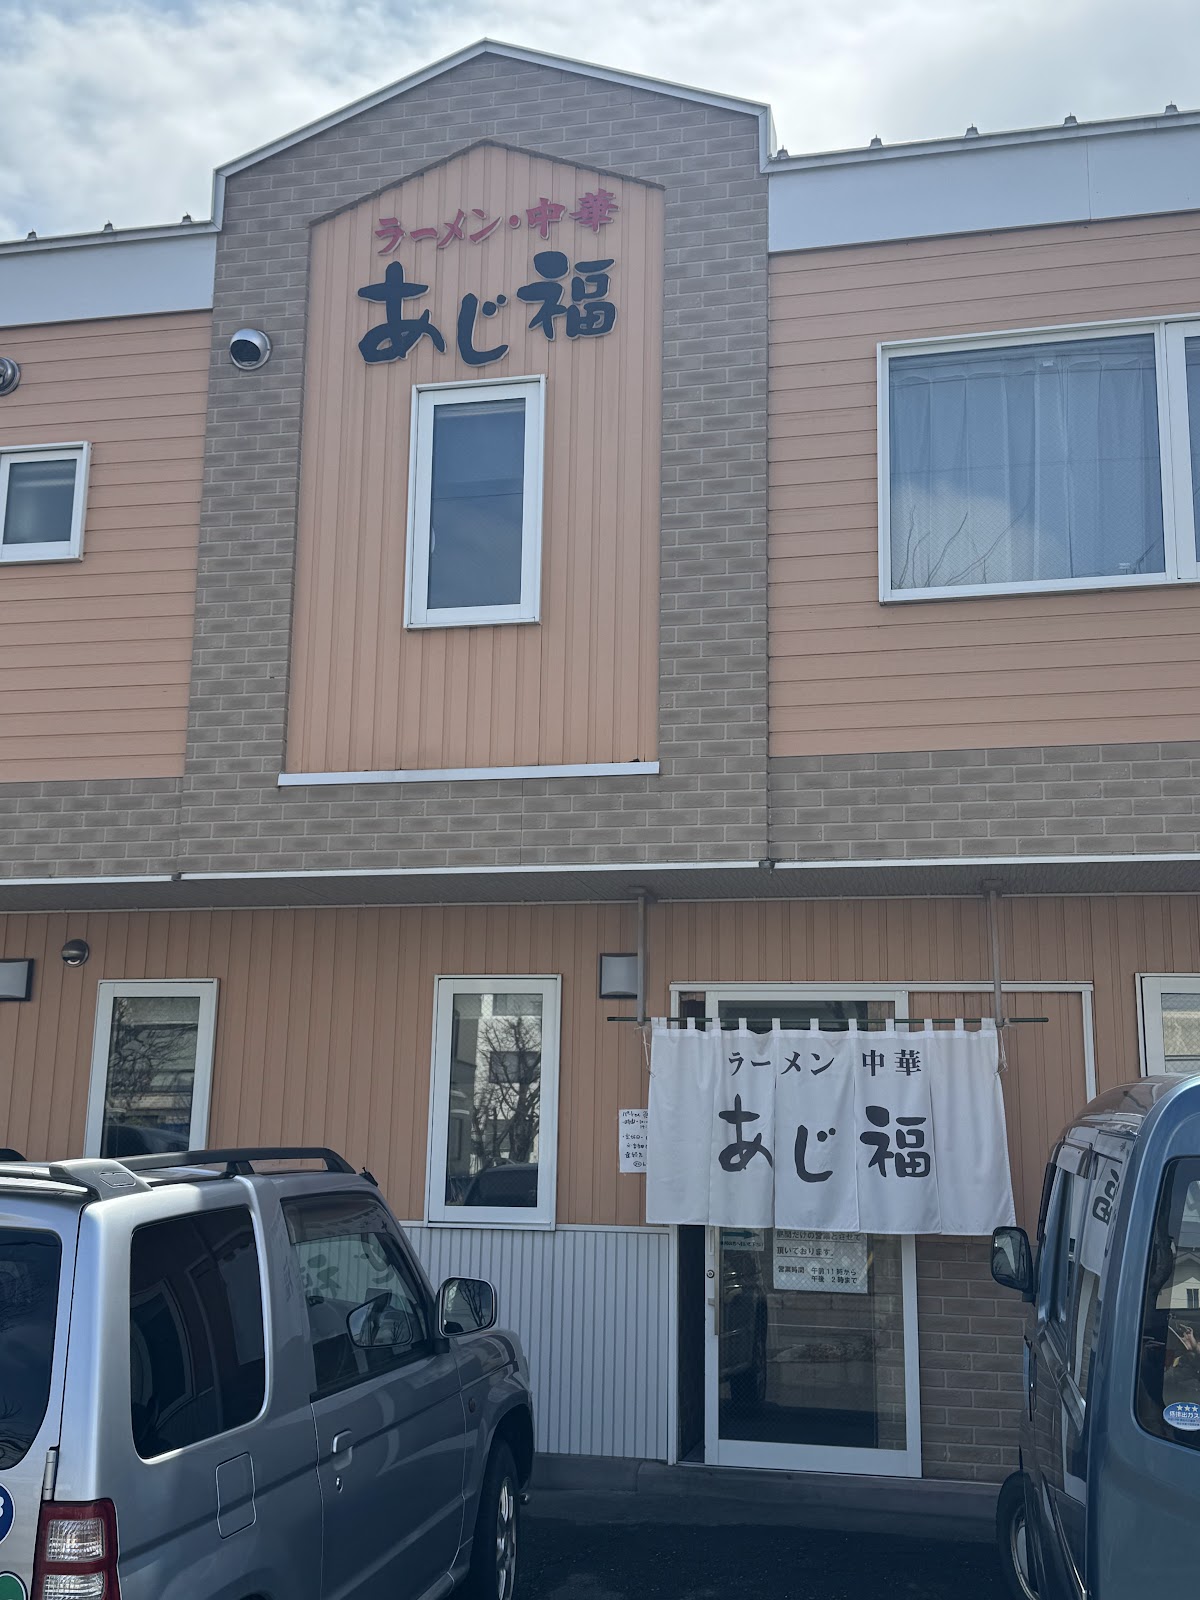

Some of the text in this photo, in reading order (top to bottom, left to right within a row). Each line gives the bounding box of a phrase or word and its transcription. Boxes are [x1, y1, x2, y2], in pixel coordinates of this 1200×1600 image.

[375, 188, 619, 256] ラーメン・中華
[357, 250, 618, 367] あじ福
[728, 1049, 922, 1077] ラーメン 中華
[718, 1093, 931, 1183] あじ福
